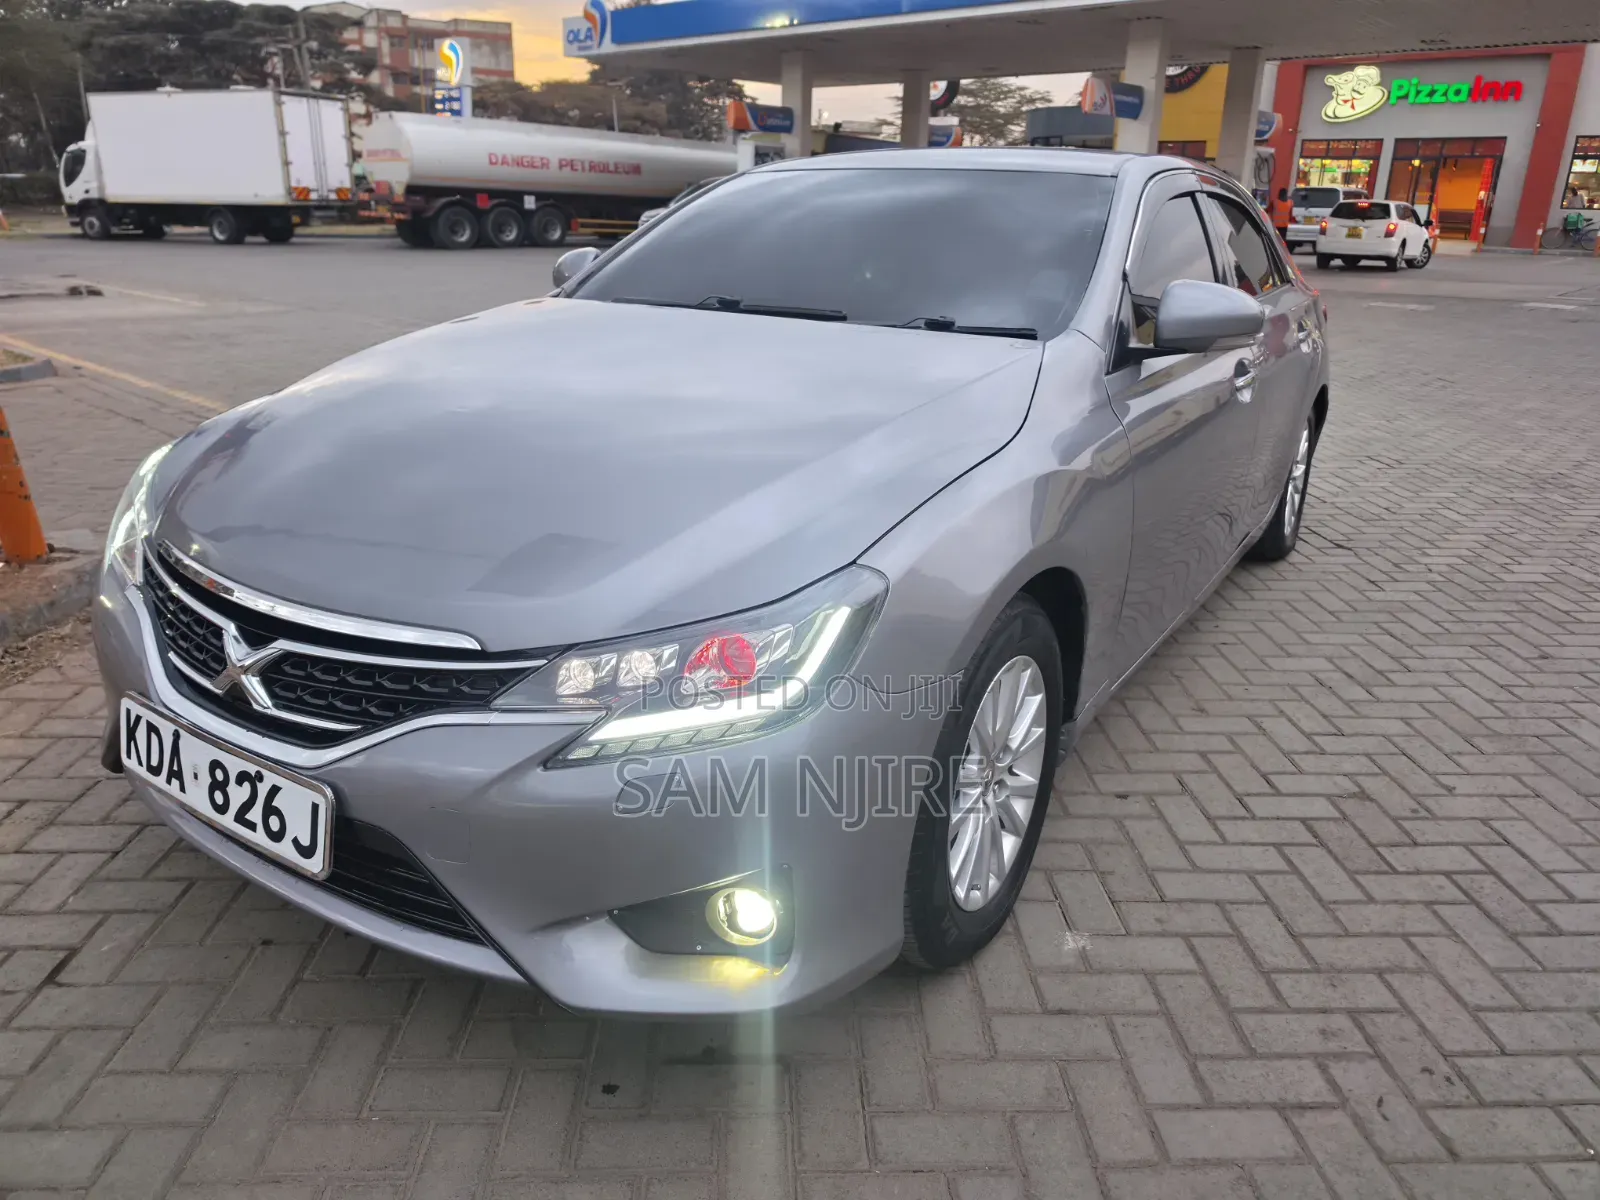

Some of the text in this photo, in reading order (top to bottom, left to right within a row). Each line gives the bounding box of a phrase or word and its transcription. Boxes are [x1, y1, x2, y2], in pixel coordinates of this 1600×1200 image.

[566, 27, 594, 44] OLA
[488, 152, 642, 176] DANGER PETROLEUM
[125, 707, 320, 860] KDA 826J
